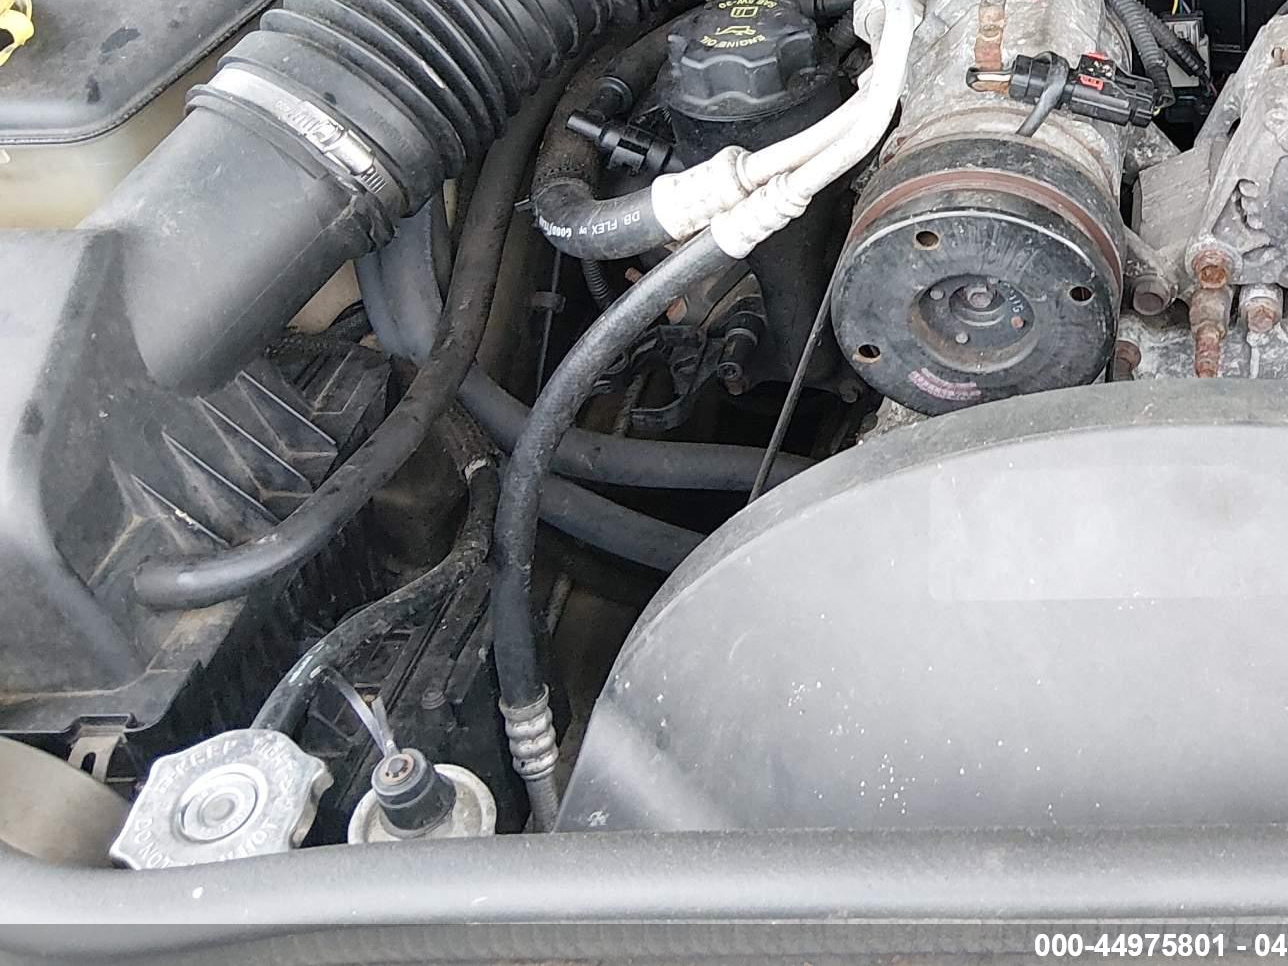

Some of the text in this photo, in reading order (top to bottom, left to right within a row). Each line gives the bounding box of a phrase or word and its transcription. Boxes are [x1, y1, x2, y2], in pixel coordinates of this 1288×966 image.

[716, 35, 767, 48] ENGINE
[623, 211, 641, 225] DB
[592, 219, 618, 236] FLEX
